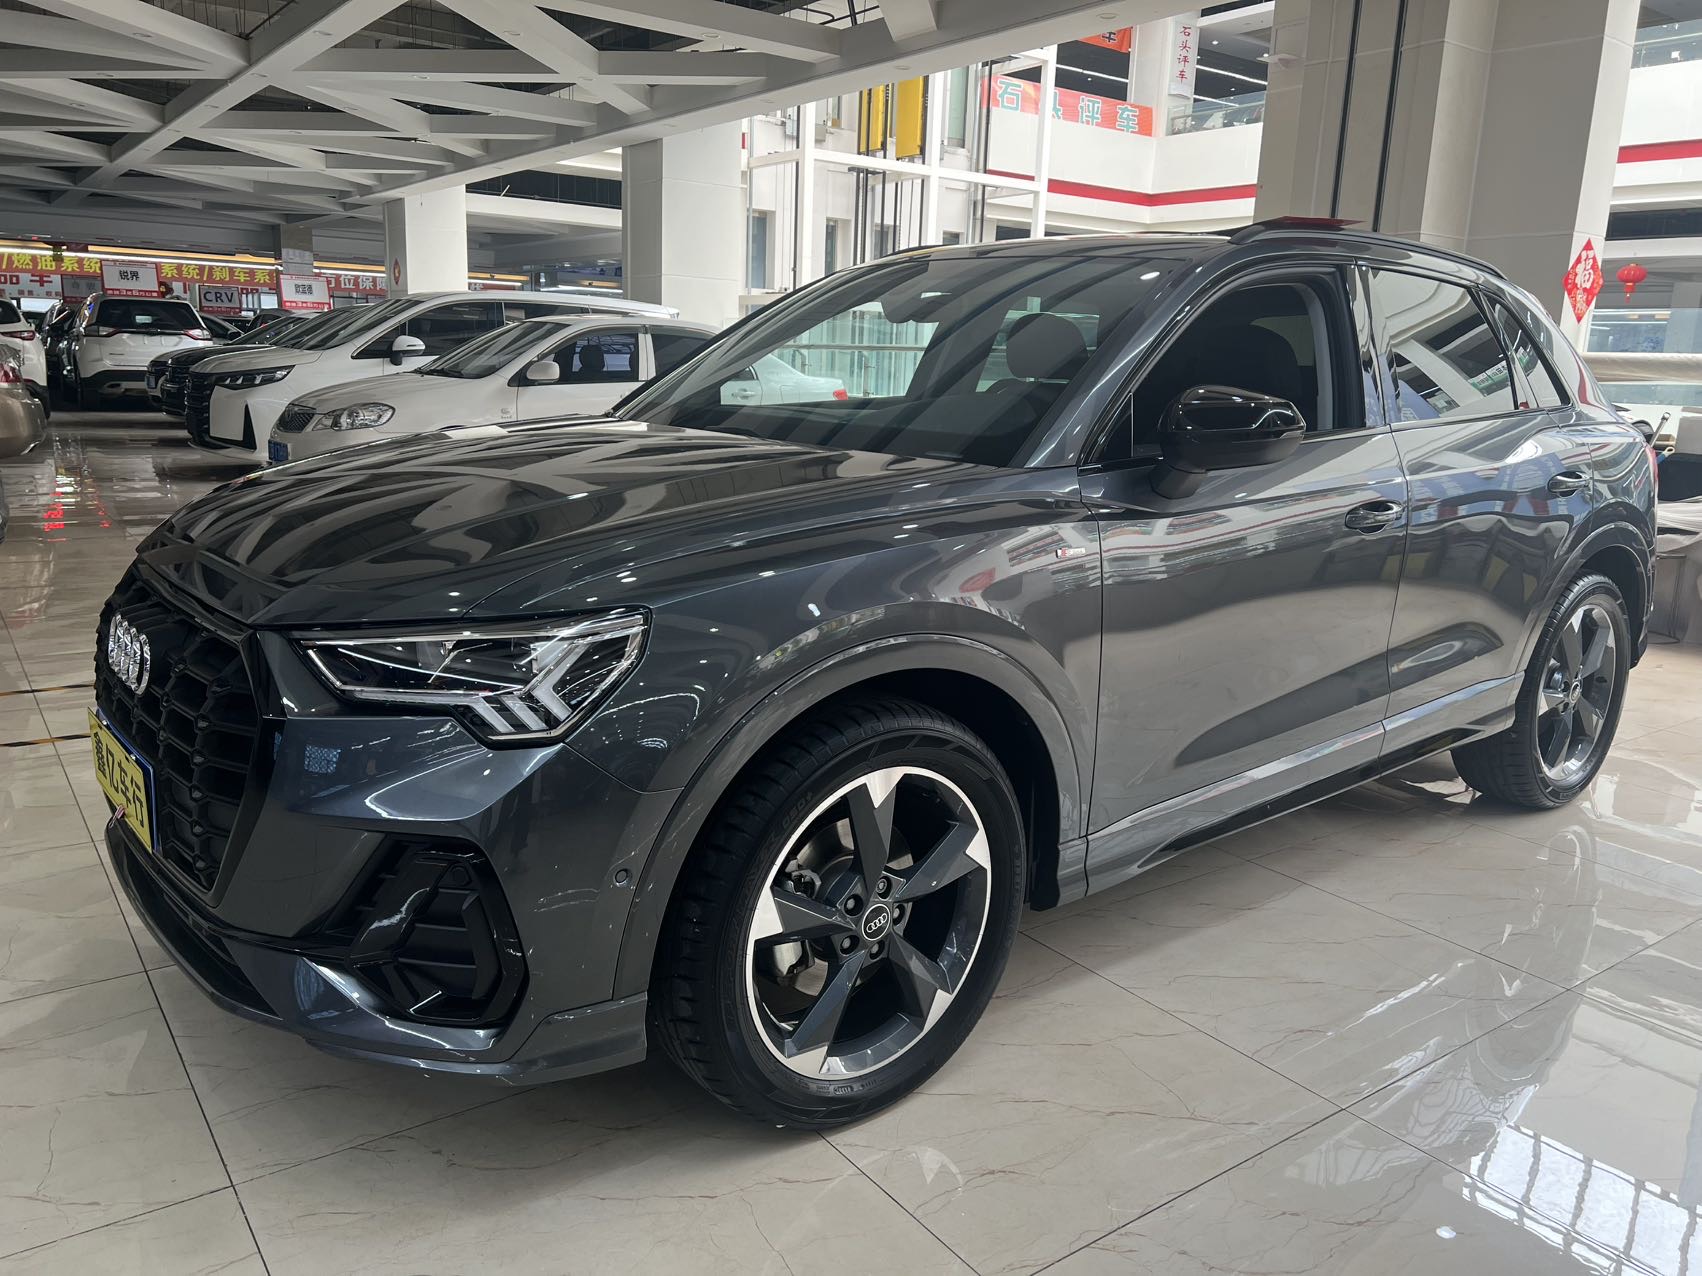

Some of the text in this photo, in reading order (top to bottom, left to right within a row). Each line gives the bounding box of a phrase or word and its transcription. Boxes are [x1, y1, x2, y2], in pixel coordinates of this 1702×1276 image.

[1176, 25, 1192, 84] 石头评车
[119, 269, 140, 281] 锐界
[160, 263, 277, 283] 系统/刹车系
[203, 291, 234, 303] CRV
[94, 732, 145, 828] 鑫亿车行
